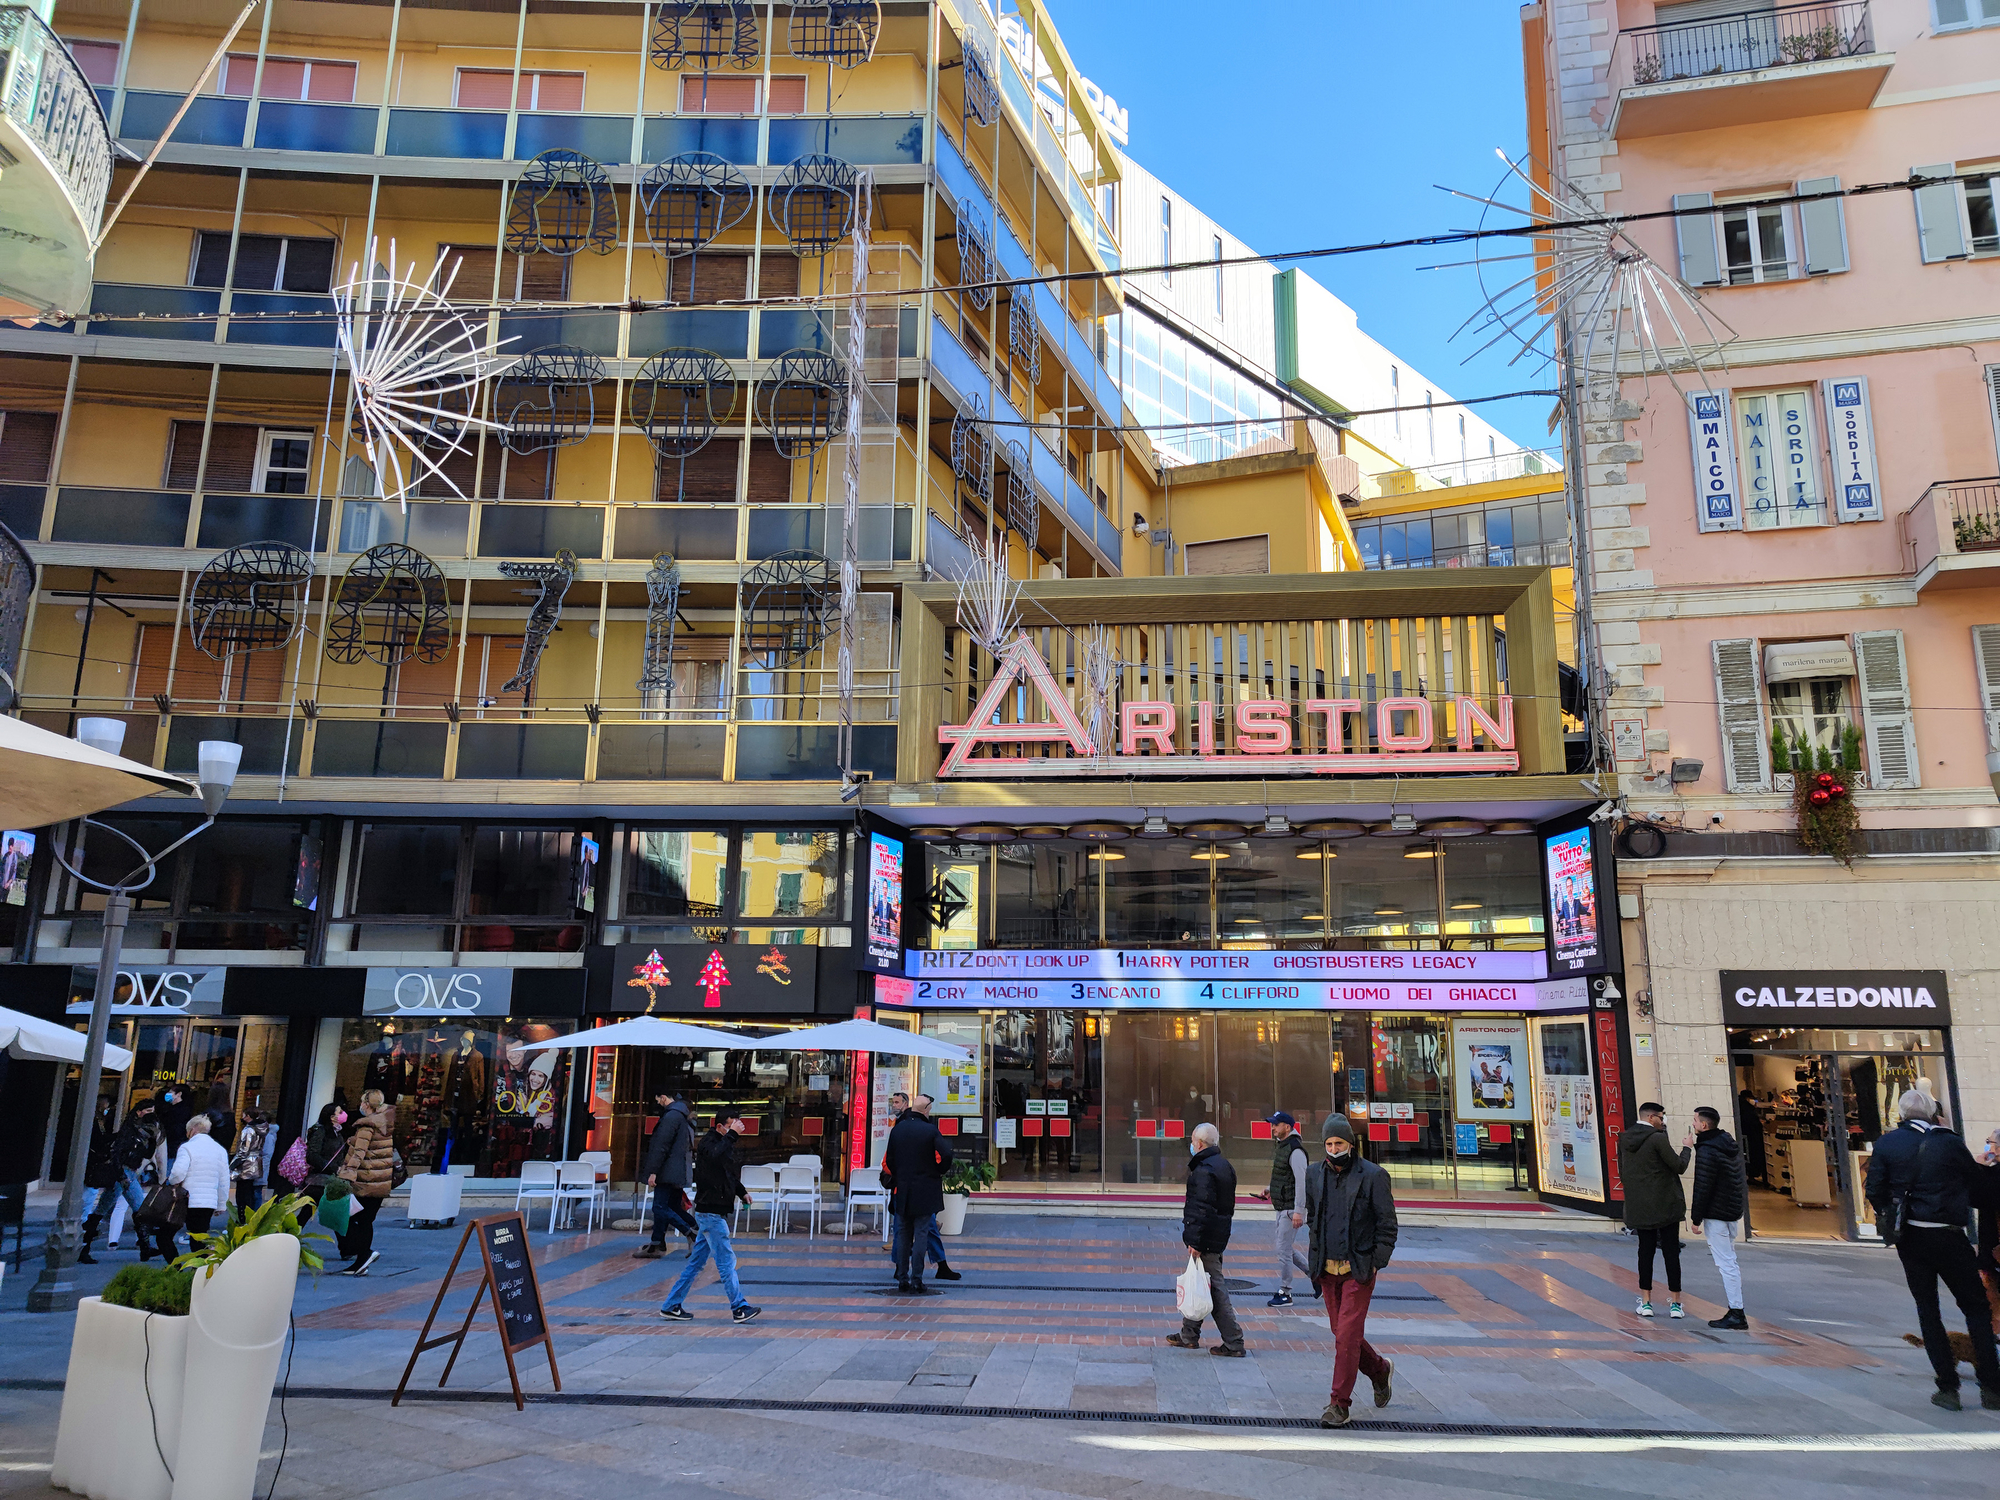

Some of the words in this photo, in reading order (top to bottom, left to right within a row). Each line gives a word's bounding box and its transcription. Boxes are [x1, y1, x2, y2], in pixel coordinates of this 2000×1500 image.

[1703, 422, 1725, 492] MAICO
[1745, 412, 1771, 513] MAICO
[1782, 657, 1816, 667] marilena
[1818, 655, 1848, 665] margari
[938, 631, 1520, 778] ARISTON
[1552, 841, 1570, 854] MOLLO
[1558, 845, 1583, 864] TUTTO
[879, 852, 897, 866] TUTTO
[868, 945, 884, 957] Cinema
[883, 948, 899, 960] Centrale
[923, 952, 974, 968] RITZ
[1116, 952, 1124, 968] 1
[1126, 956, 1183, 968] HARRY
[1191, 956, 1249, 968] POTTER
[1556, 950, 1575, 961] Cinema
[1574, 946, 1597, 958] Centrale
[976, 955, 1019, 967] DON'T
[1025, 955, 1063, 967] LOOK
[1068, 955, 1090, 967] UP
[1273, 956, 1403, 968] GHOSTBUSTERS
[1413, 956, 1477, 969] LEGACY
[1569, 958, 1584, 970] 21.00
[111, 971, 193, 1009] OVS
[394, 973, 482, 1010] OVS
[918, 982, 932, 998] 2
[937, 987, 967, 999] CRY
[985, 987, 1038, 999] MACHO
[1071, 983, 1085, 1000] 3
[1087, 986, 1161, 999] ENCANTO
[1200, 983, 1214, 999] 4
[1222, 987, 1299, 999] CLIFFORD
[1330, 987, 1390, 1000] L'UOMO
[1408, 987, 1432, 1000] DEI
[1449, 988, 1517, 1001] GHIACCI
[1538, 990, 1565, 1000] Cinema
[1735, 987, 1937, 1008] CALZEDONIA
[1598, 1017, 1618, 1116] CINEMA
[497, 1090, 553, 1113] OVS
[1540, 1091, 1557, 1126] UP
[1574, 1092, 1593, 1129] UP
[1563, 1175, 1577, 1183] OGGI
[494, 1234, 514, 1245] MORETTI
[495, 1227, 510, 1236] BIRRA
